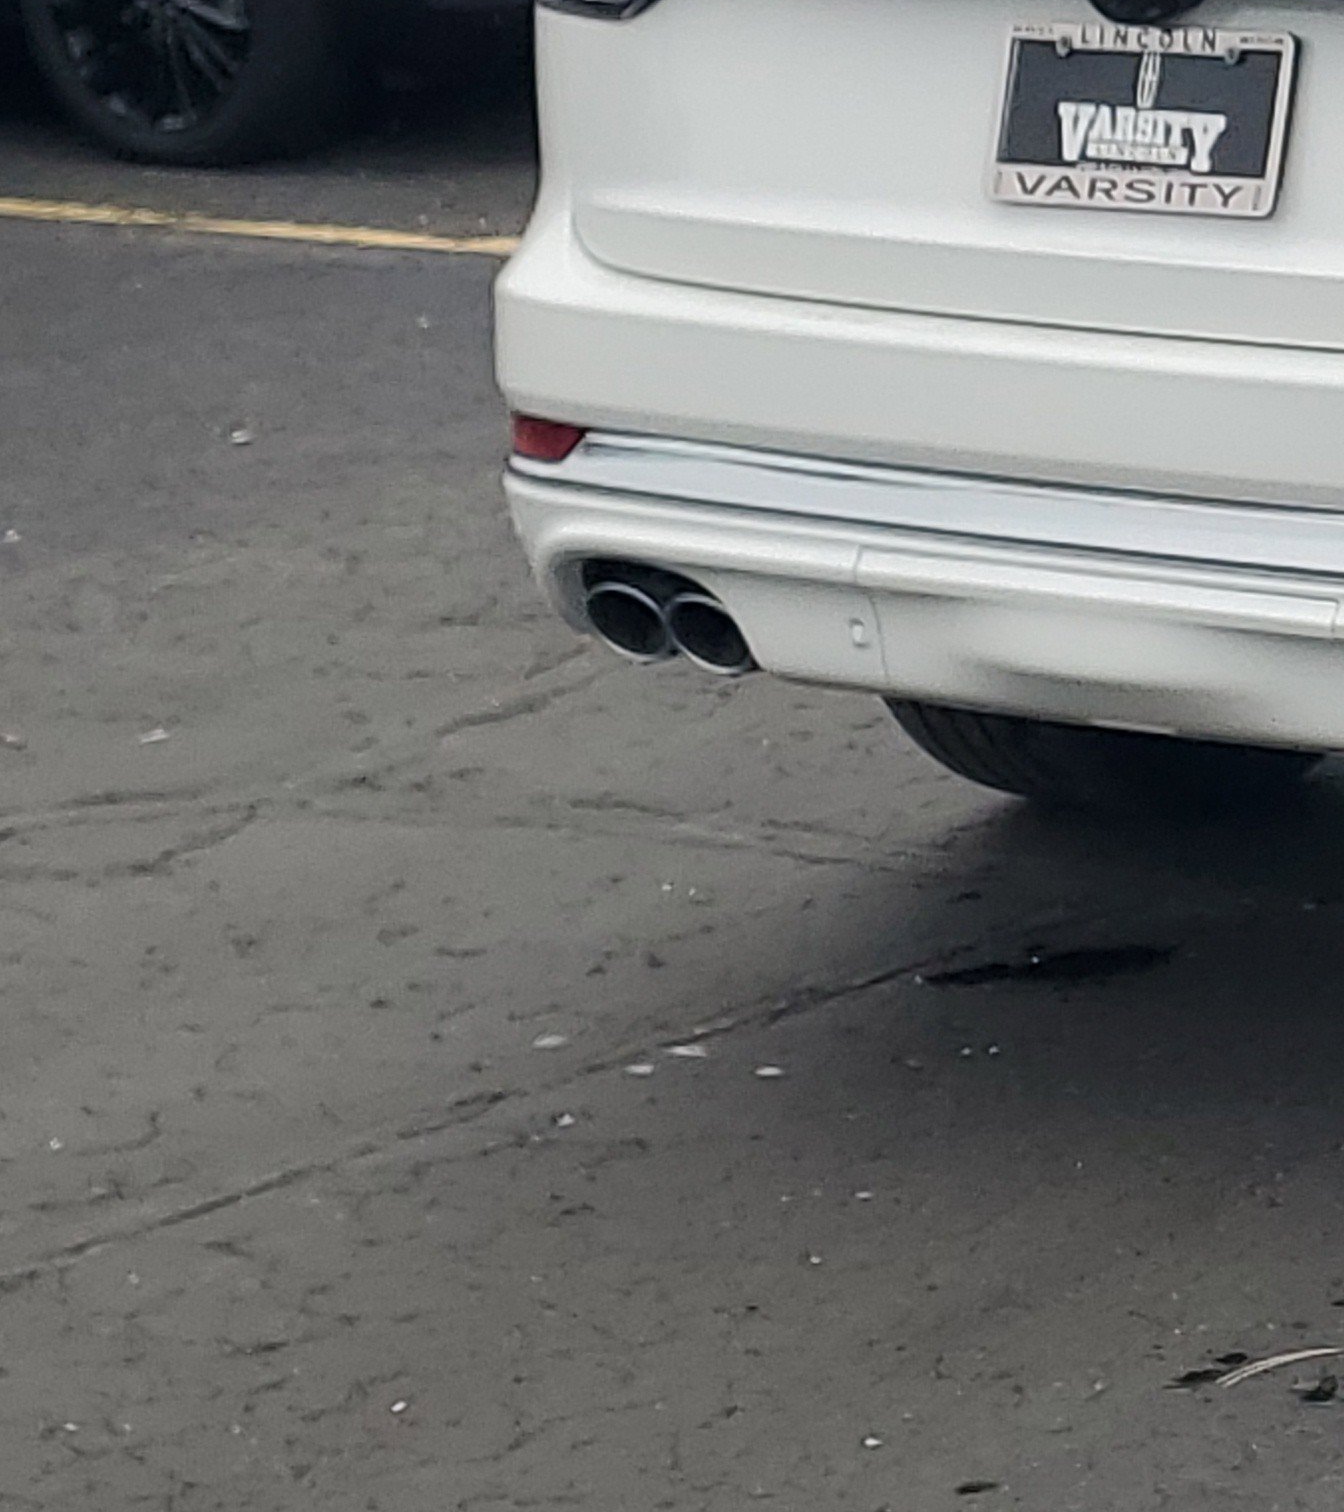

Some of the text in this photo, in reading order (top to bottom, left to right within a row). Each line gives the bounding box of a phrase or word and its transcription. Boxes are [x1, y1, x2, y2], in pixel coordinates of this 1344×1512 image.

[1080, 24, 1217, 53] LINCOLN
[1057, 100, 1227, 174] VARSITY
[1015, 170, 1243, 210] VARSITY
